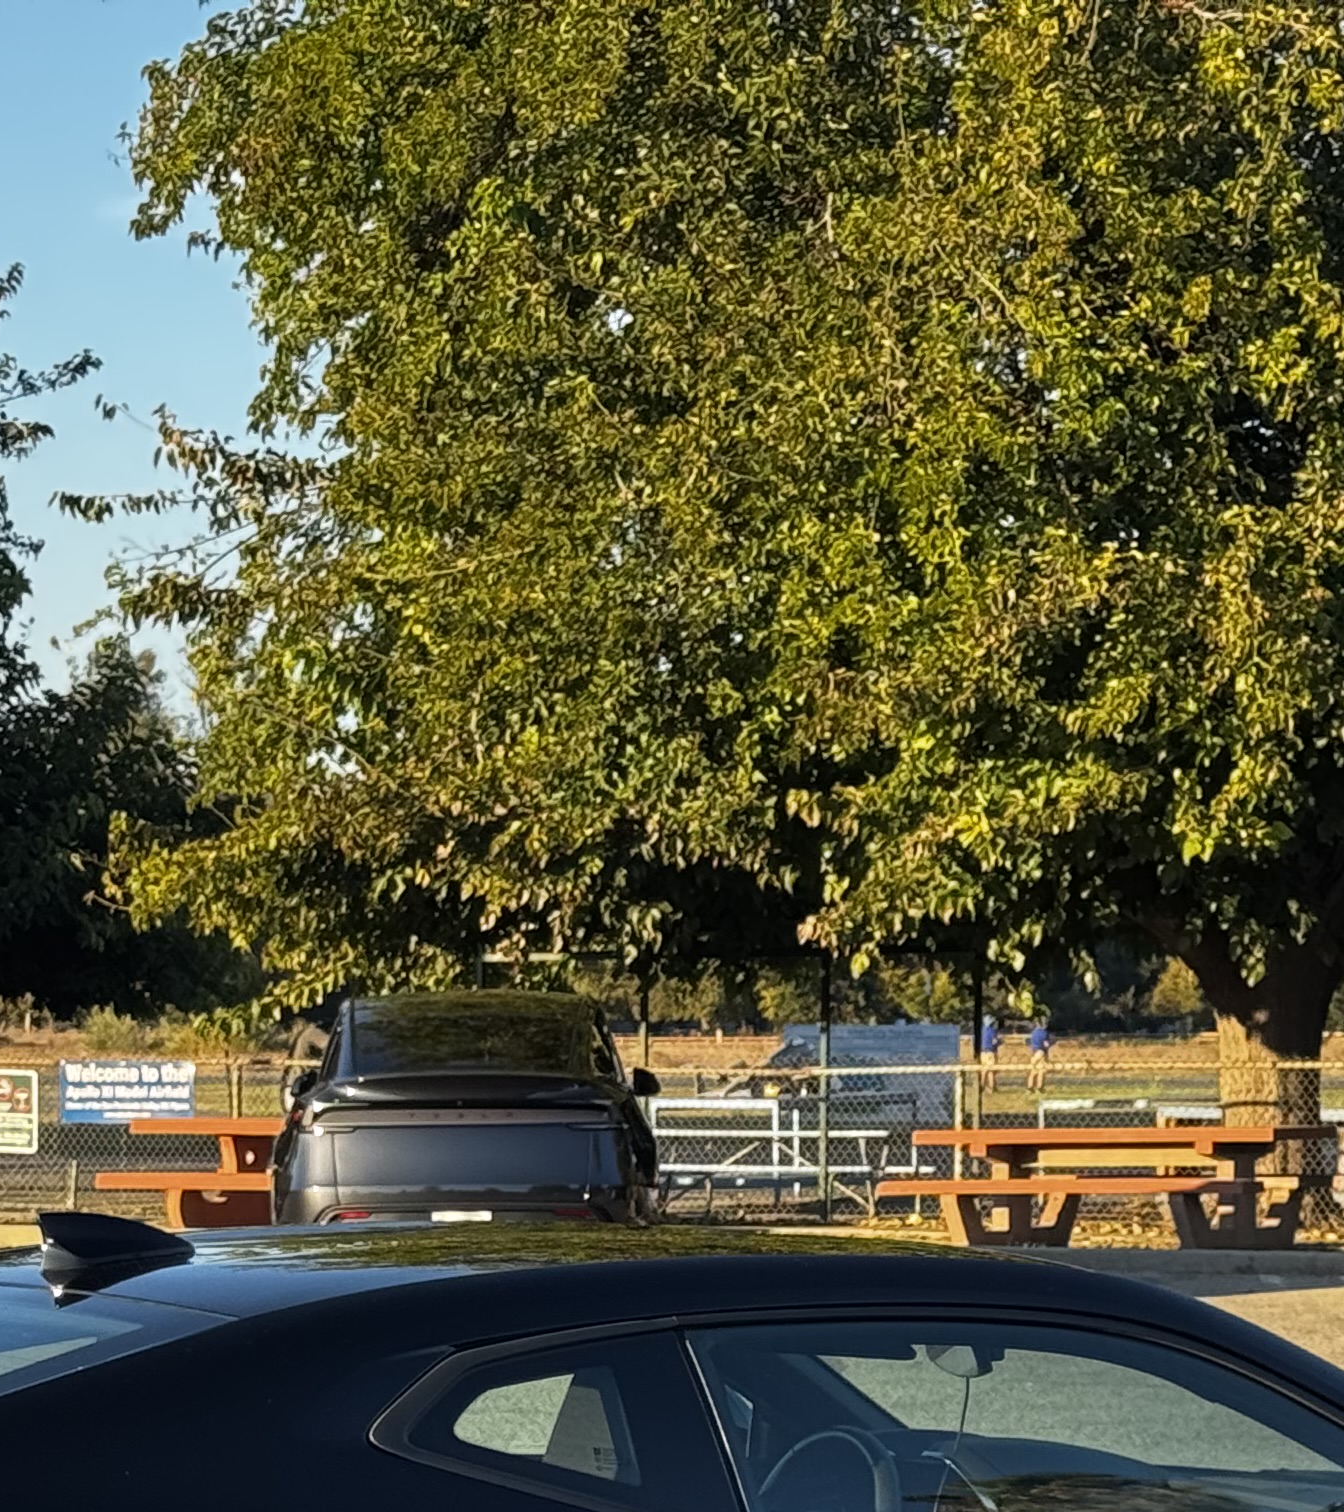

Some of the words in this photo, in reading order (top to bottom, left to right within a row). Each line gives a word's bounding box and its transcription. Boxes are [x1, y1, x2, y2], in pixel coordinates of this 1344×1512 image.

[65, 1062, 140, 1083] Welcome
[141, 1064, 160, 1083] to
[161, 1062, 191, 1083] the
